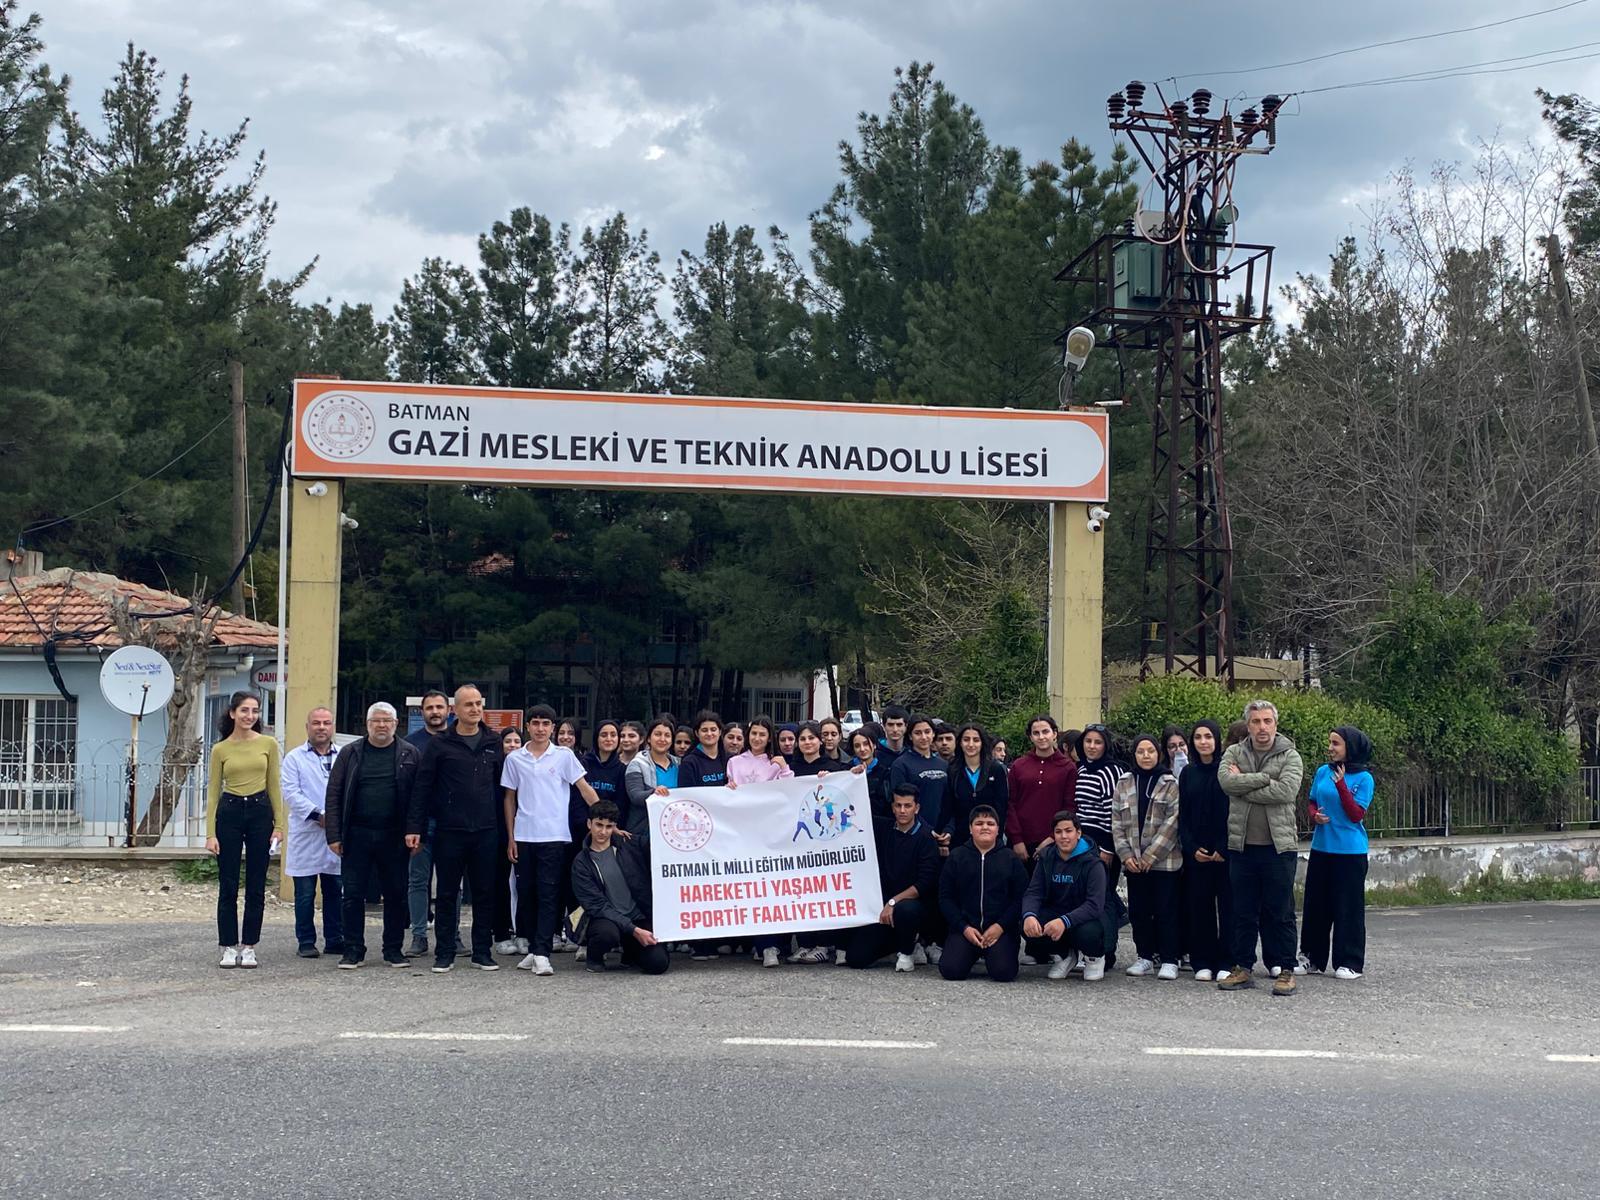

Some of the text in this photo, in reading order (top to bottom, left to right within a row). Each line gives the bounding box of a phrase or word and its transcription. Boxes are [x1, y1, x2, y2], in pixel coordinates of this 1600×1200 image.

[388, 403, 470, 422] BATMAN
[388, 425, 469, 457] GAZİ
[479, 431, 619, 462] MESLEKİ
[626, 437, 668, 464] VE
[674, 436, 790, 468] TEKNİK
[796, 444, 951, 475] ANADOLU
[960, 445, 1048, 477] LİSESİ
[661, 844, 866, 878] BATMAN İL MİLLİ EĞİTİM MÜDÜRLÜĞÜ
[680, 872, 853, 903] HAREKETLİ YAŞAM VE
[680, 898, 857, 930] SPORTİF FAALİYETLER
